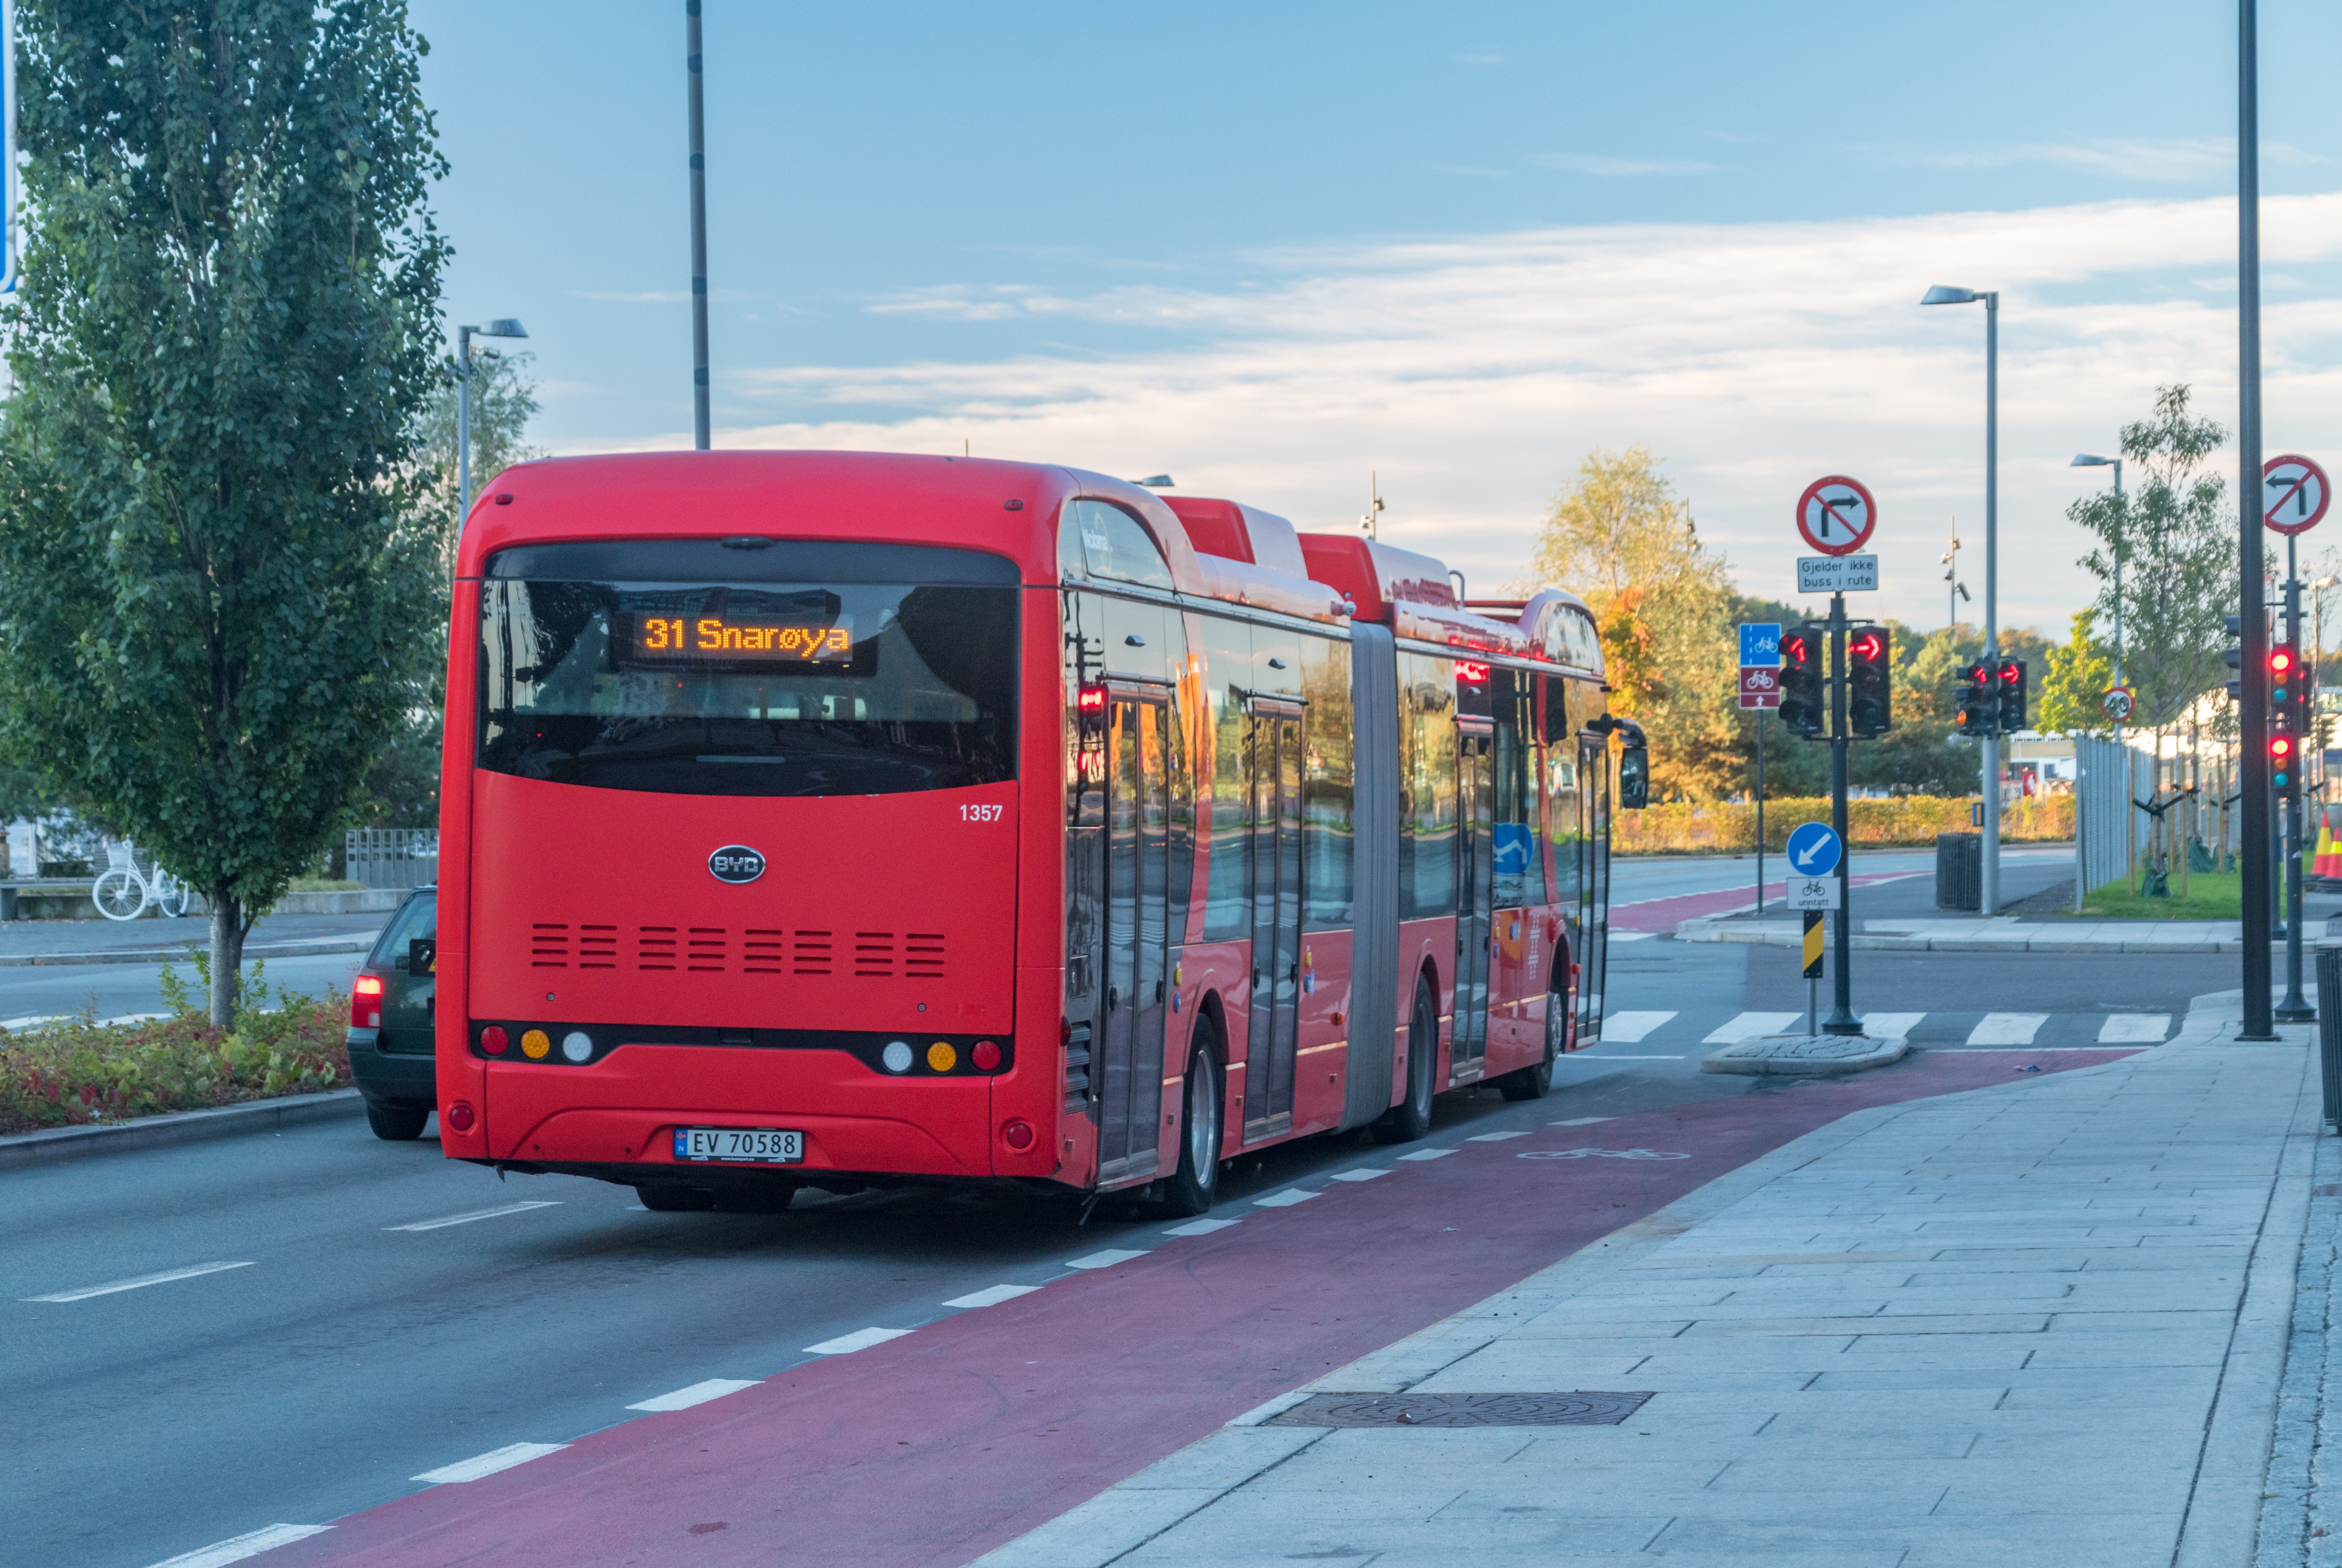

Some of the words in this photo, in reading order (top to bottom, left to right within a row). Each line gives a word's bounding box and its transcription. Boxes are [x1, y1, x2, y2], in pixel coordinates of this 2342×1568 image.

[1802, 561, 1843, 575] Gjelder
[1850, 559, 1873, 570] ikke
[1804, 577, 1832, 587] buss
[1838, 575, 1841, 585] i
[1848, 575, 1872, 585] rute
[645, 619, 683, 649] 31
[697, 619, 848, 658] Snarøya
[960, 804, 1003, 821] 1357
[715, 856, 759, 873] BYD
[694, 1133, 719, 1153] EV
[729, 1133, 795, 1154] 70588
